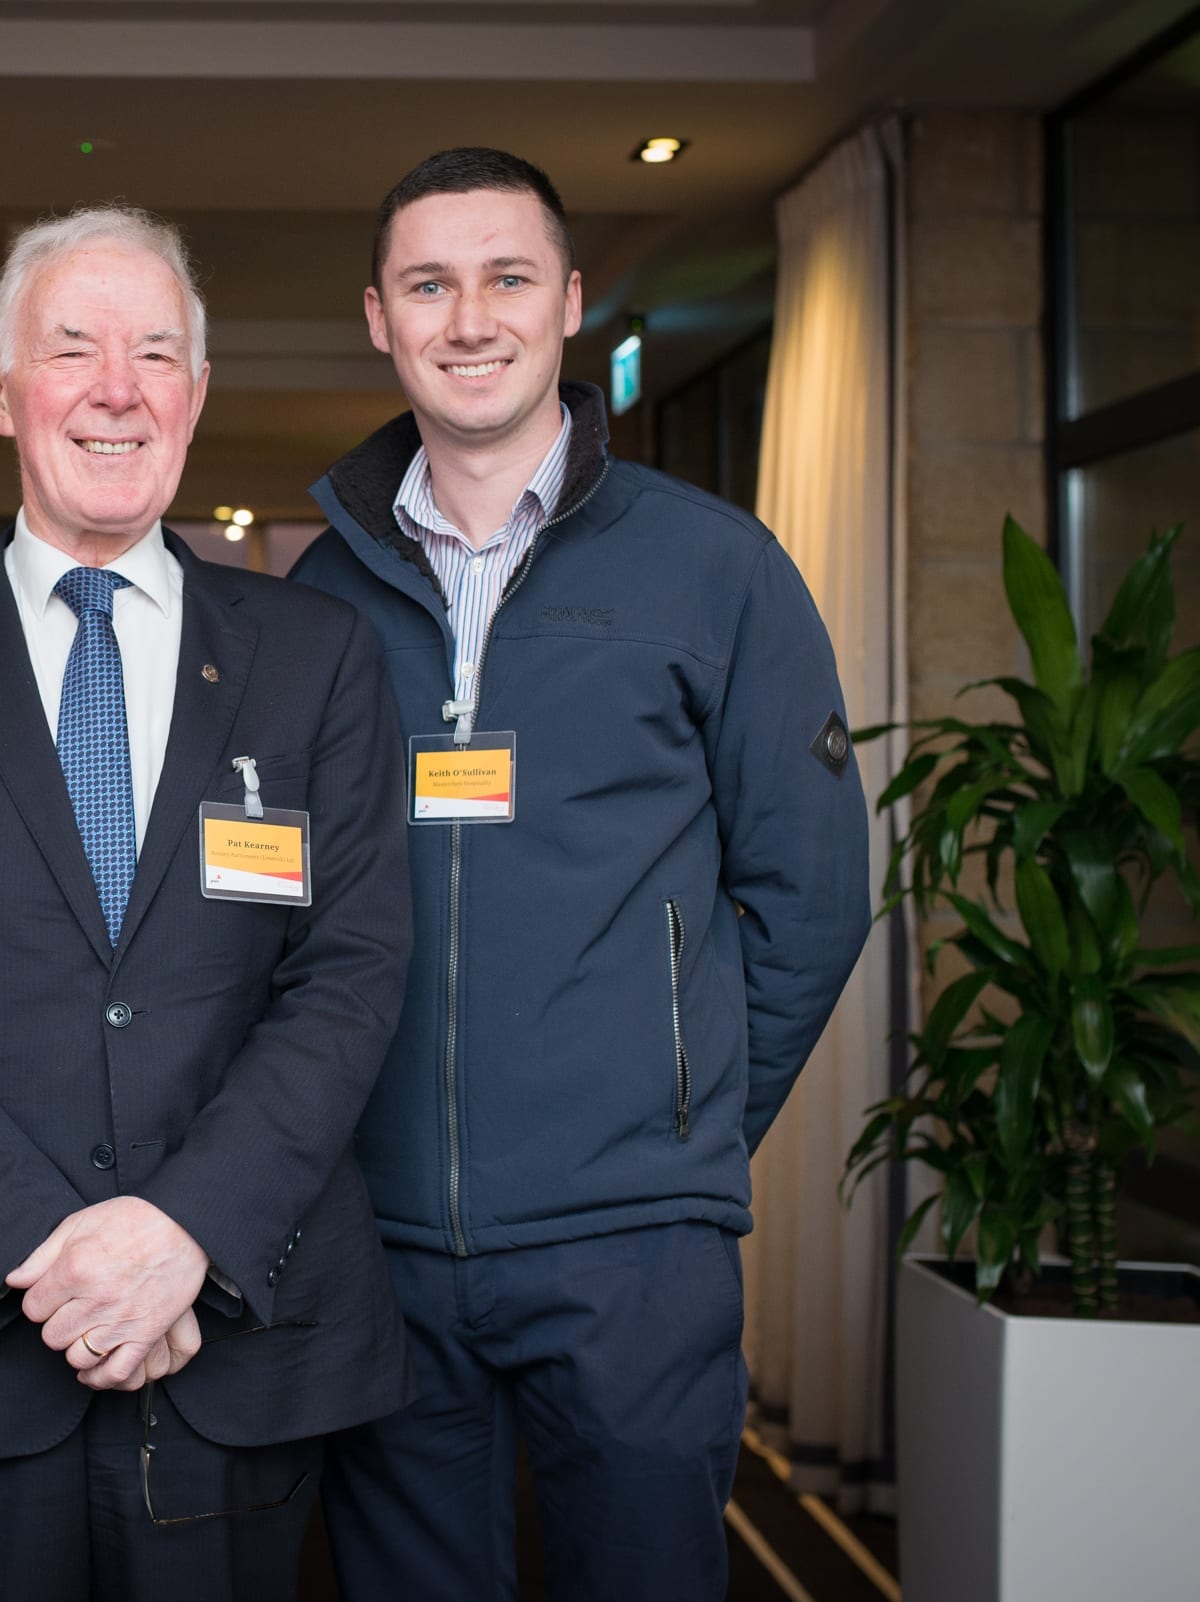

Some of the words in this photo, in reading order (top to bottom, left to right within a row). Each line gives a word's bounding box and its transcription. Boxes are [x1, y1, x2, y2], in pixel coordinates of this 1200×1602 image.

[428, 769, 451, 777] Keith
[453, 768, 497, 777] O'Sullivan
[228, 839, 242, 847] Pat
[244, 841, 280, 852] Kearney
